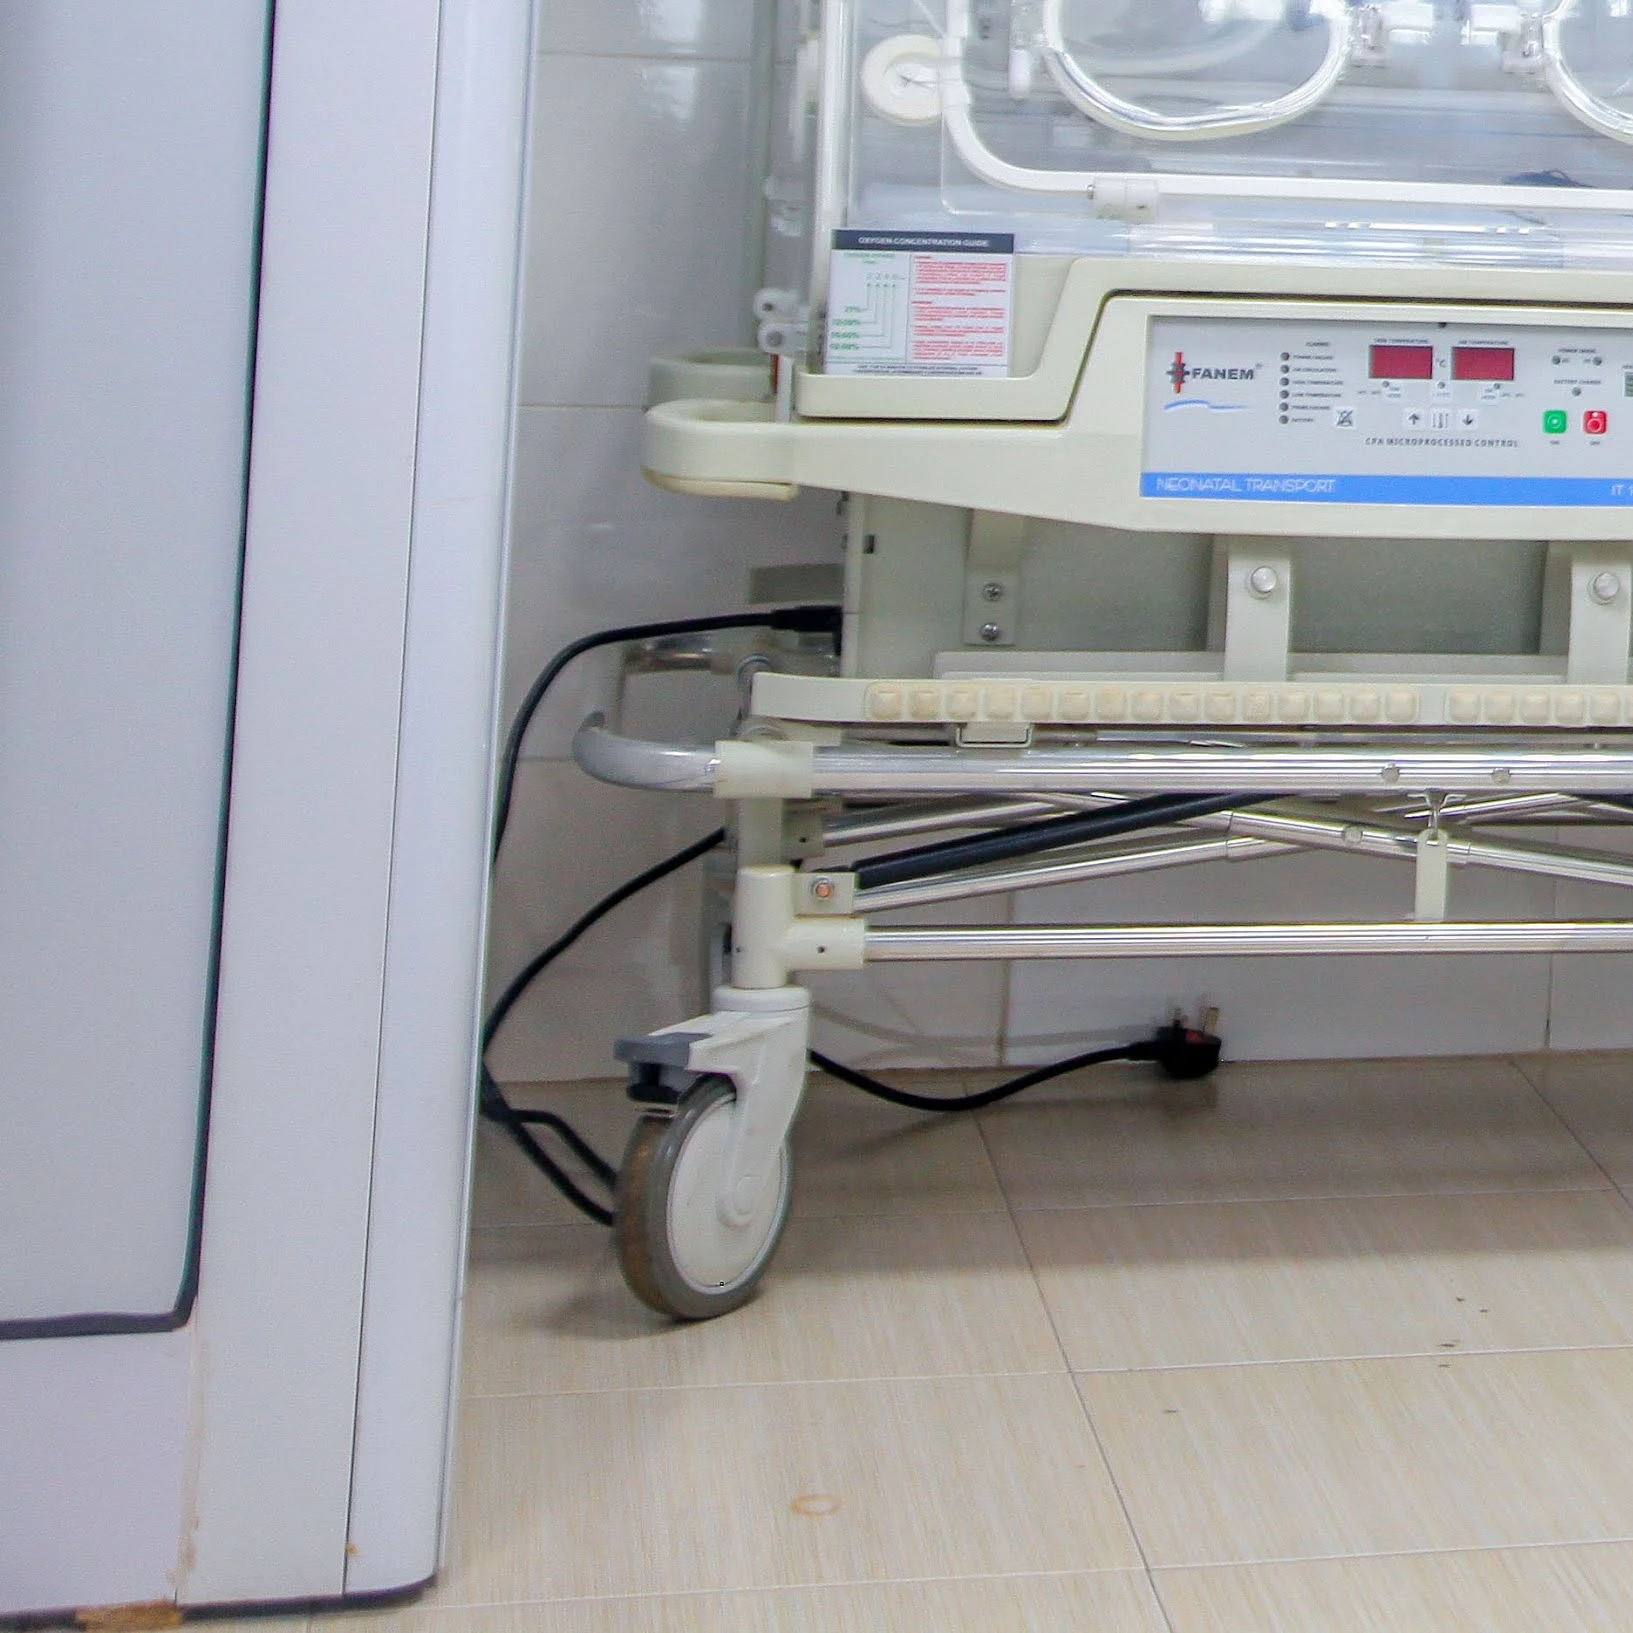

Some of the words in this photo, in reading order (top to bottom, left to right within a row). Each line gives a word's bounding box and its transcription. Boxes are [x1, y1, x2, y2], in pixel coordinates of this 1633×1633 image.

[1386, 437, 1473, 448] MICROPROCESSED
[1475, 438, 1519, 448] CONTROL
[1155, 476, 1242, 493] NEONATAL
[1244, 478, 1338, 494] TRANSPORT
[1610, 484, 1625, 497] IT
